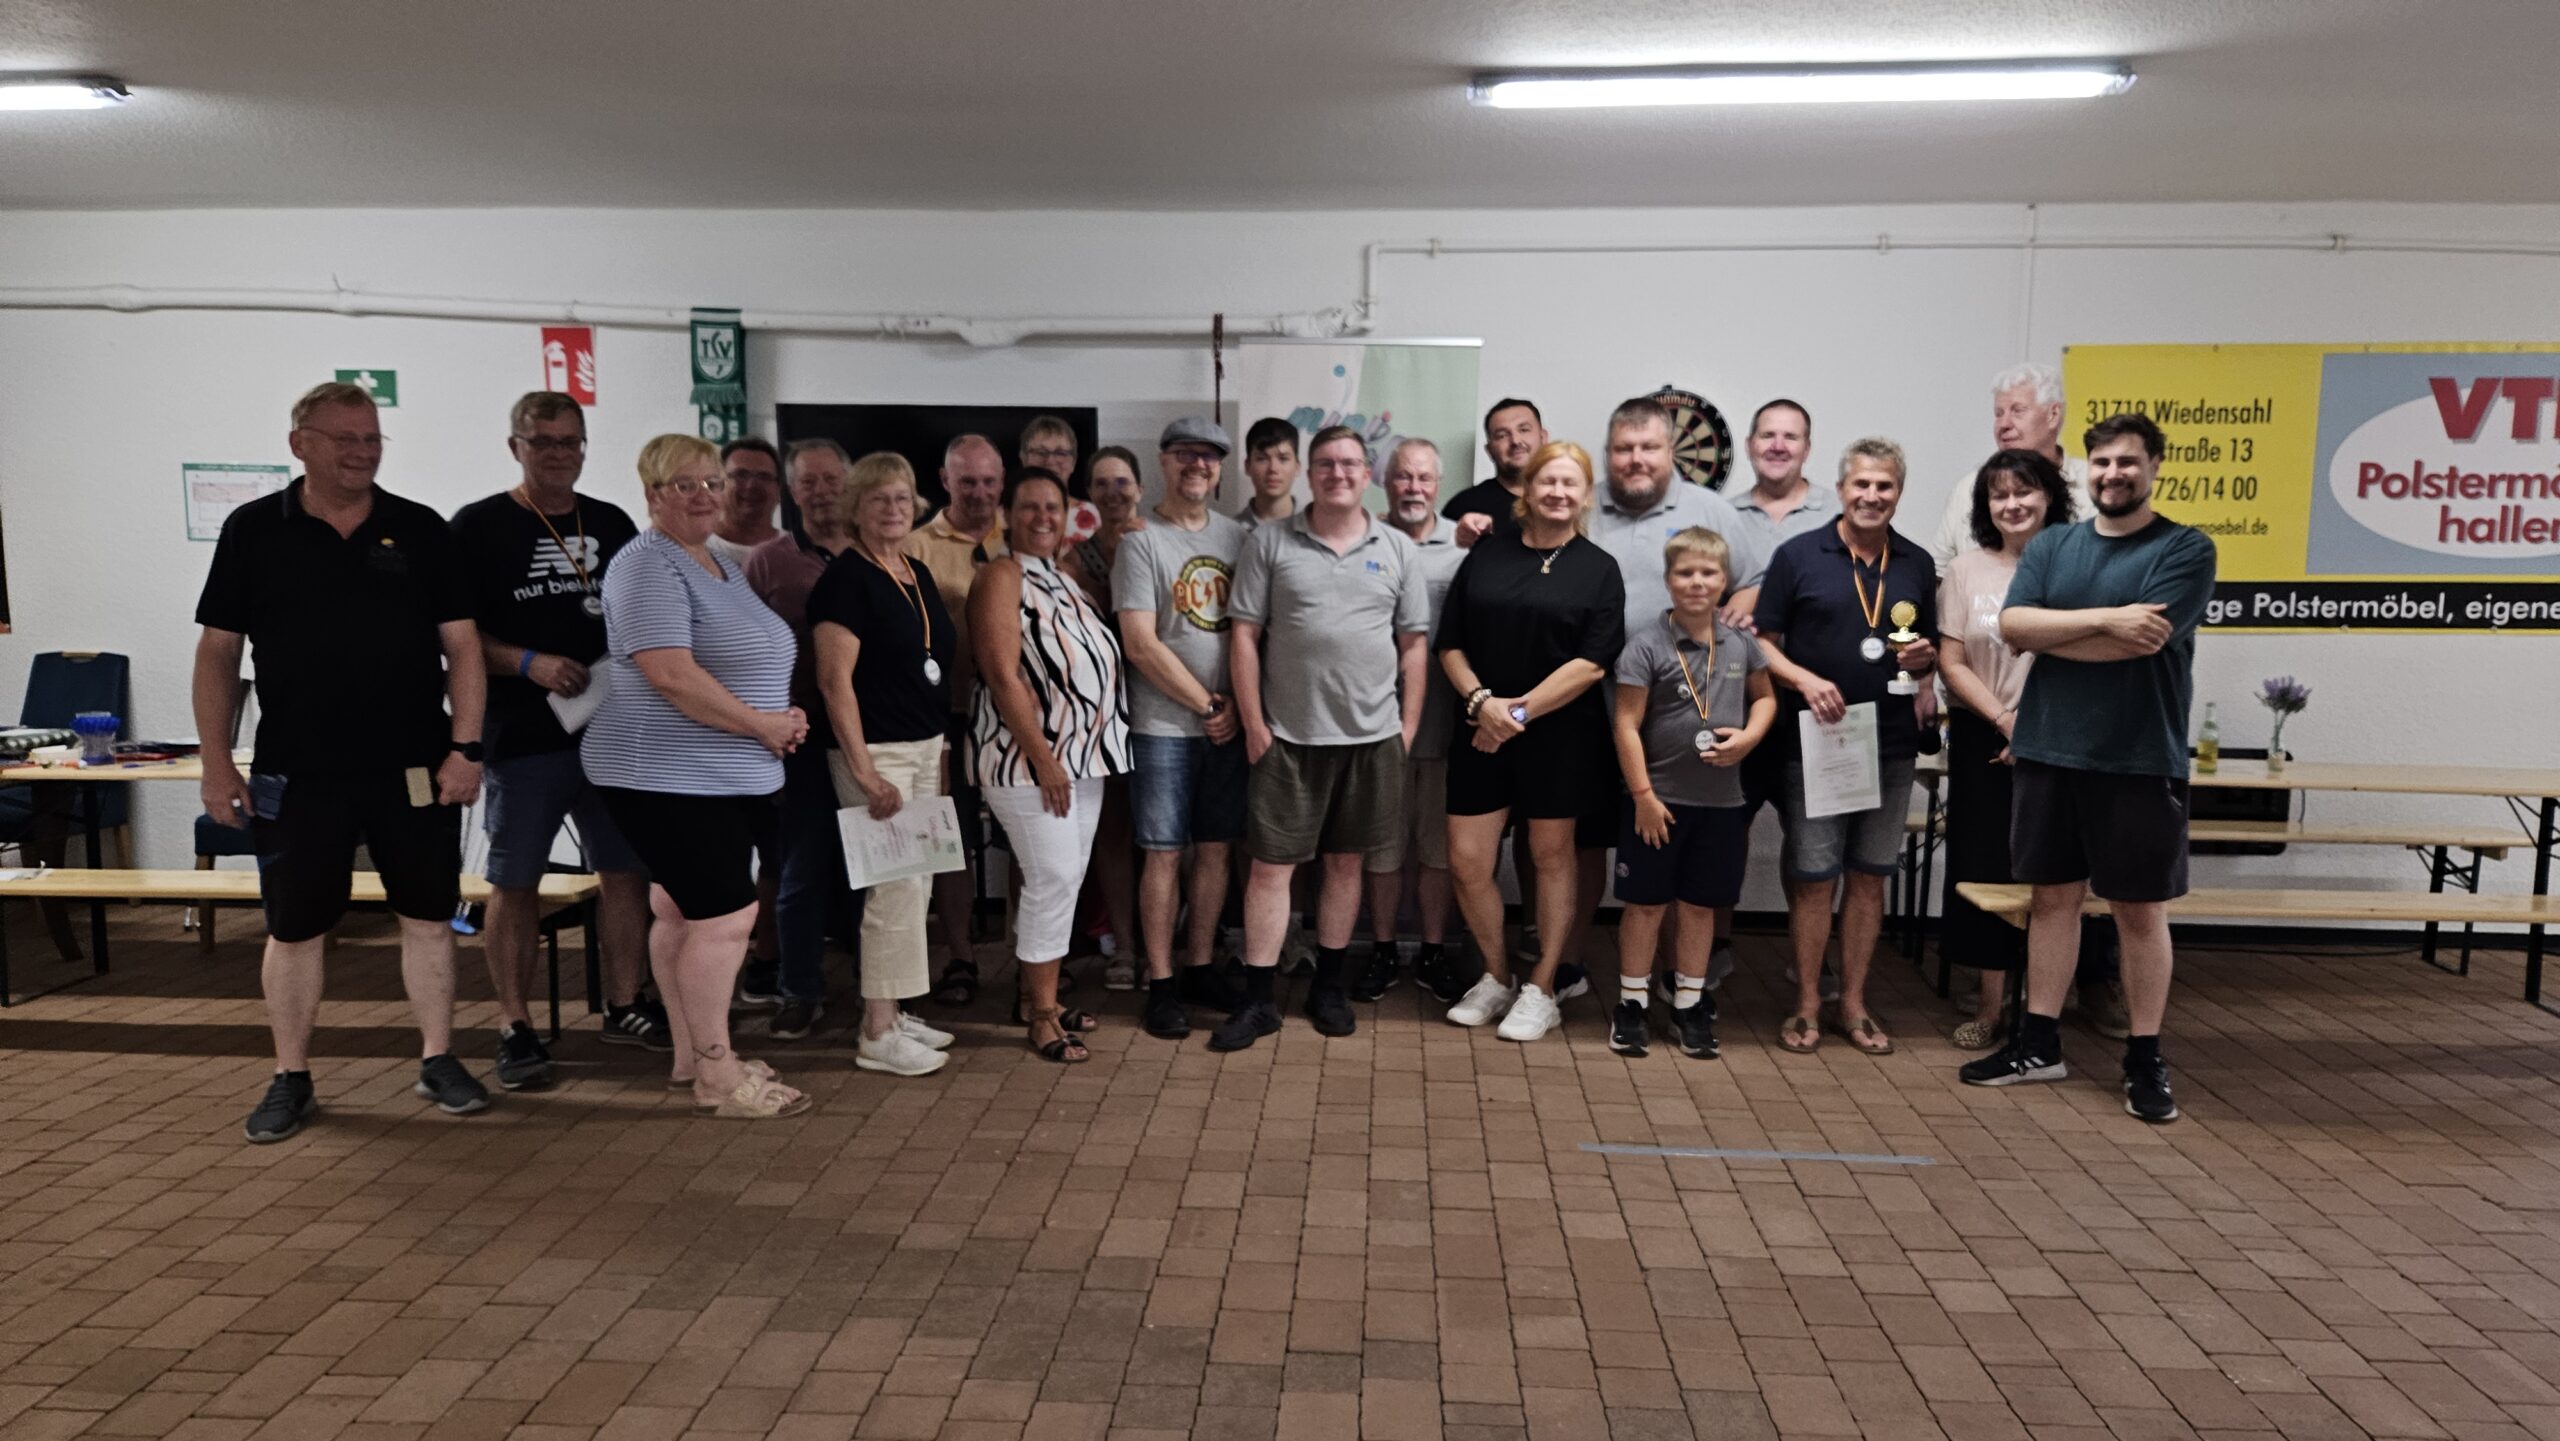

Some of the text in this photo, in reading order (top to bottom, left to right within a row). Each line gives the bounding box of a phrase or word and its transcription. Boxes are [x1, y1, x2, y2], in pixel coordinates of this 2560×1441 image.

[2153, 398, 2273, 425] Wiedensahl
[2429, 376, 2560, 444] VT
[2162, 437, 2254, 463] traße 13
[2151, 475, 2258, 504] 726/14 00
[513, 583, 545, 602] nur
[2205, 598, 2243, 625] ge
[2253, 591, 2455, 624] Polstermöbel,
